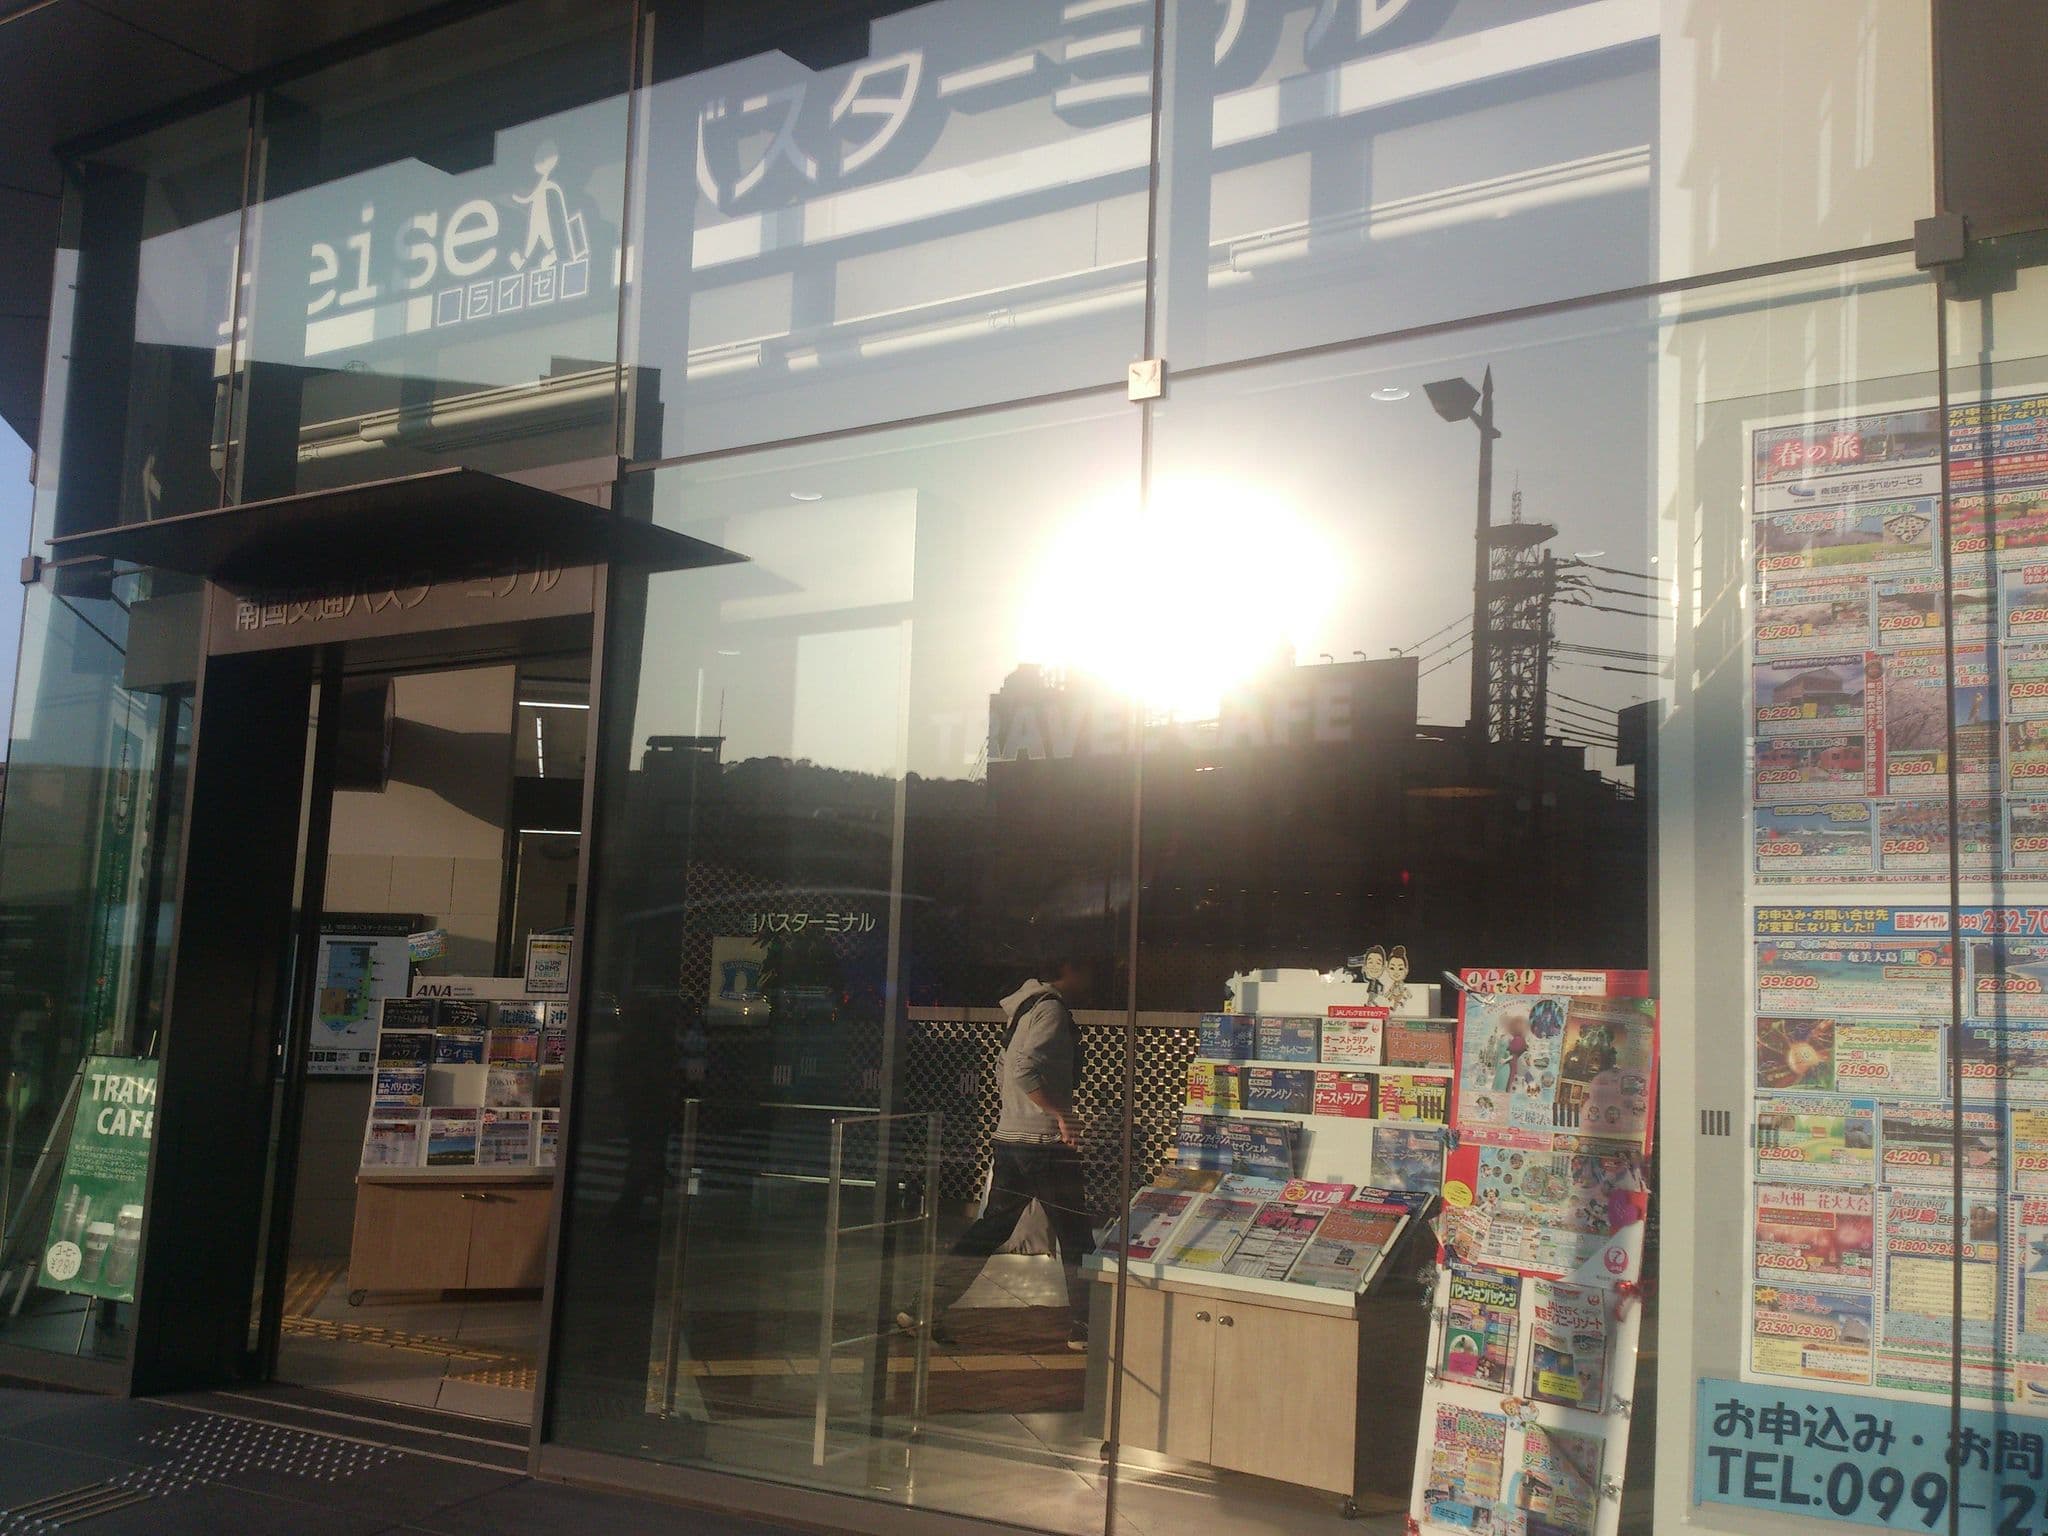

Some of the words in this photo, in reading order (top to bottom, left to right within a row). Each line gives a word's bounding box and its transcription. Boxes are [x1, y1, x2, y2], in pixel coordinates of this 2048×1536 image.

[1776, 433, 1861, 468] 春の旅
[1820, 477, 1923, 495] 南国交通トラベルサービス
[1757, 909, 1888, 922] お申込み・お問い合せ先
[416, 985, 452, 997] ANA
[1323, 1035, 1369, 1045] オーストラリア
[1323, 1044, 1376, 1055] ニュージーランド
[91, 1074, 156, 1106] TRAV
[1316, 1092, 1368, 1105] オーストラリア
[1888, 1207, 1938, 1224] バリ島
